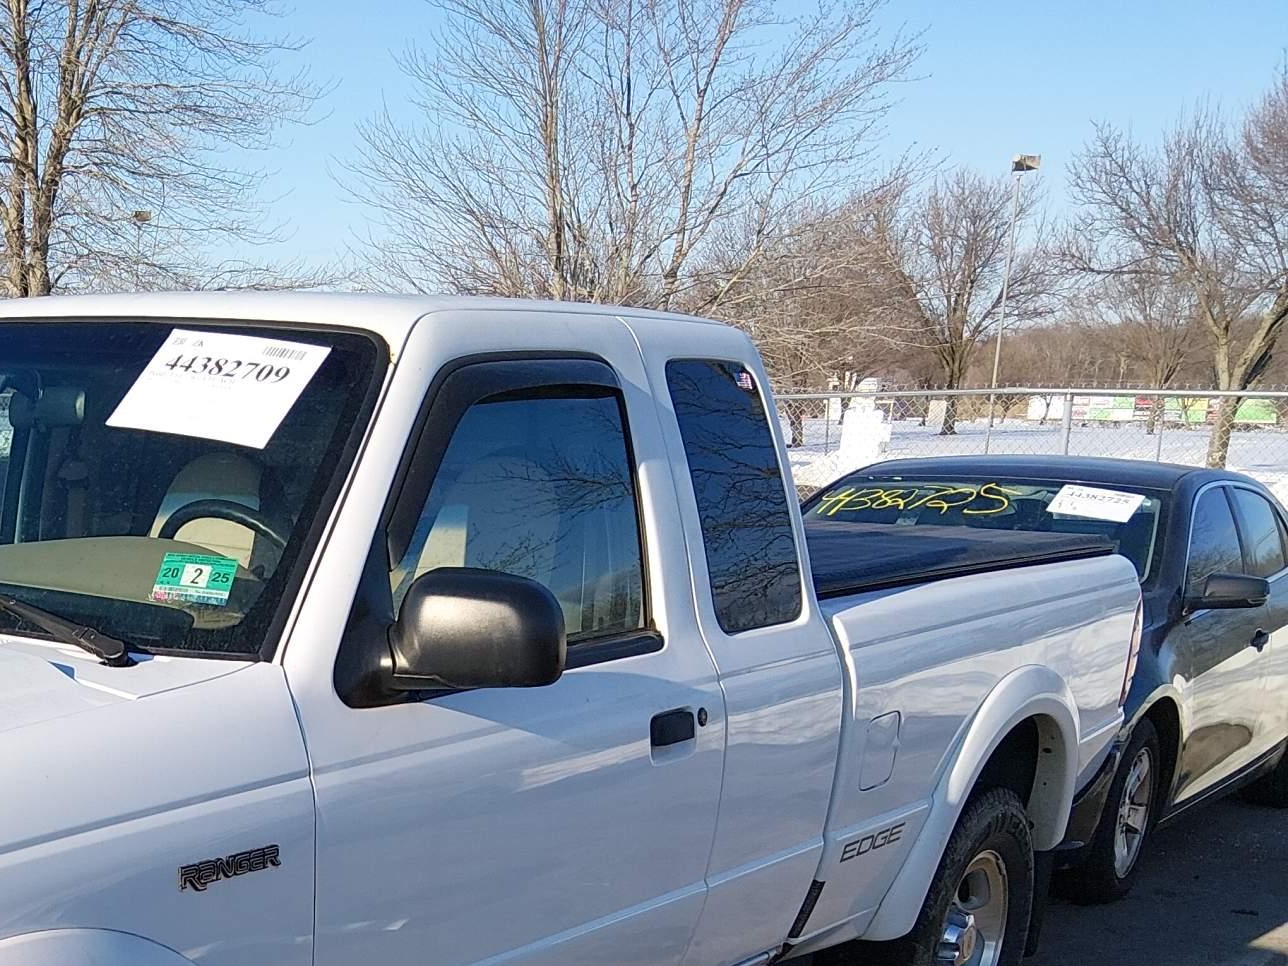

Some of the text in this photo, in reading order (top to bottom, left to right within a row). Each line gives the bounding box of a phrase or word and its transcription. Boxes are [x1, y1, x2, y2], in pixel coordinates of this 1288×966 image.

[165, 353, 291, 384] 44382709
[162, 567, 231, 585] 20 2 25
[839, 821, 906, 863] EDGE
[178, 844, 282, 892] RANGER
